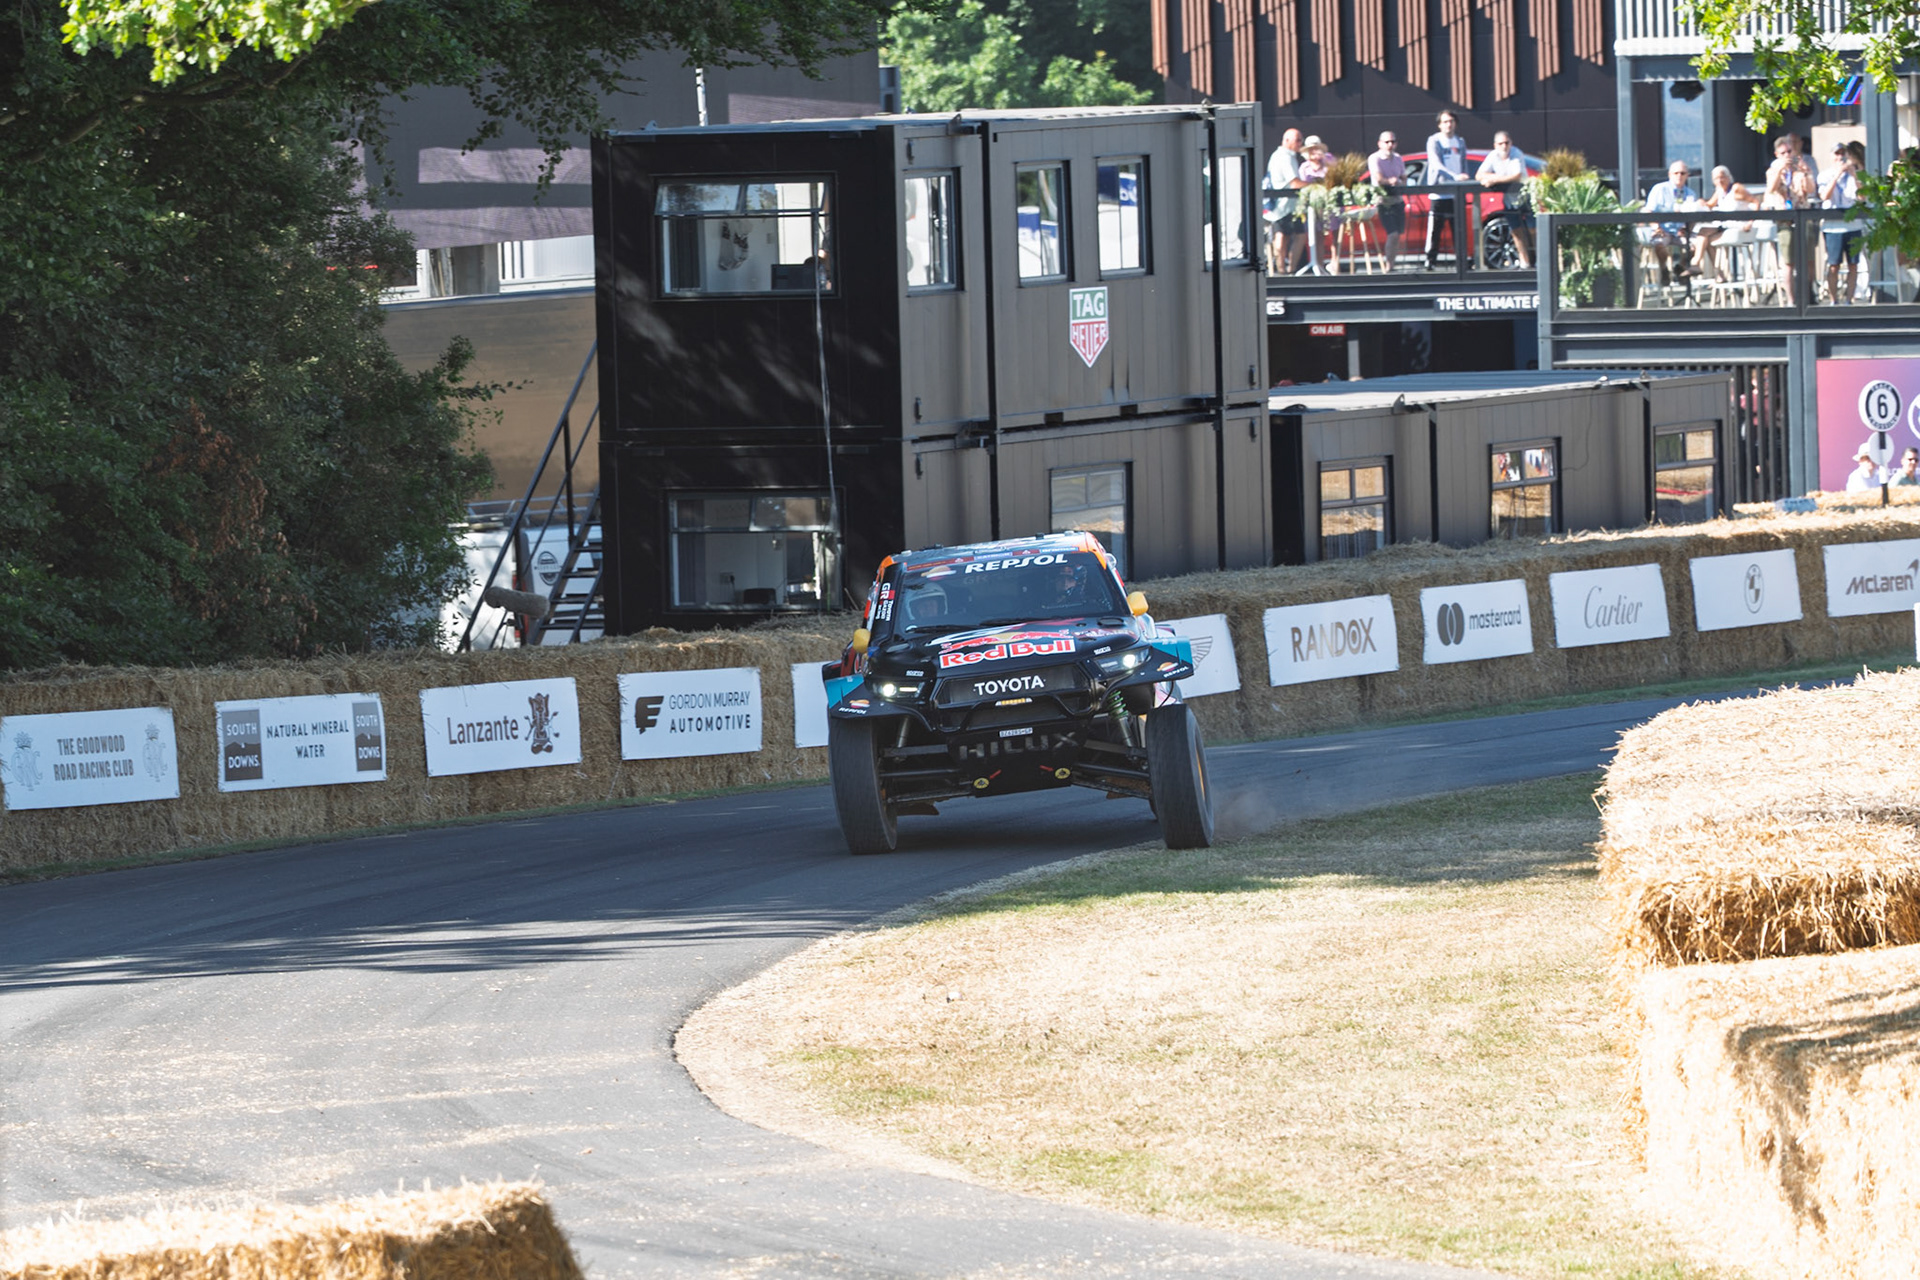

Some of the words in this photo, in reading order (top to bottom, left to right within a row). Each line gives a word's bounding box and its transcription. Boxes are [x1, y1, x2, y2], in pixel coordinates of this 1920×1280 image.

[1072, 292, 1105, 318] TAG
[1437, 297, 1465, 310] THE
[1466, 295, 1532, 310] ULTIMATE
[1311, 325, 1327, 334] ON
[1327, 325, 1344, 334] AIR
[1071, 322, 1107, 361] HEUER
[1877, 394, 1888, 419] 6
[964, 553, 1068, 574] REPSOL
[1845, 573, 1914, 596] McLaren
[1469, 604, 1522, 631] mastercard
[1584, 585, 1643, 630] Cartier
[1291, 617, 1377, 663] RANDOX
[940, 643, 1008, 668] Red
[1010, 638, 1074, 658] Bull
[1163, 666, 1189, 678] REPSOL
[974, 674, 1045, 696] TOYOTA
[668, 693, 712, 710] GORDON
[713, 690, 751, 707] MURRAY
[226, 722, 257, 736] SOUTH
[266, 724, 309, 739] NATURAL
[311, 719, 350, 736] MINERAL
[356, 714, 378, 728] SOUTH
[447, 716, 519, 746] Lanzante
[669, 714, 751, 734] AUTOMOTIVE
[57, 738, 75, 755] THE
[77, 734, 126, 754] GOODWOOD
[295, 744, 326, 759] WATER
[960, 732, 1078, 760] HILUX
[53, 763, 78, 781] ROAD
[79, 760, 111, 779] RACING
[113, 758, 134, 777] CLUB
